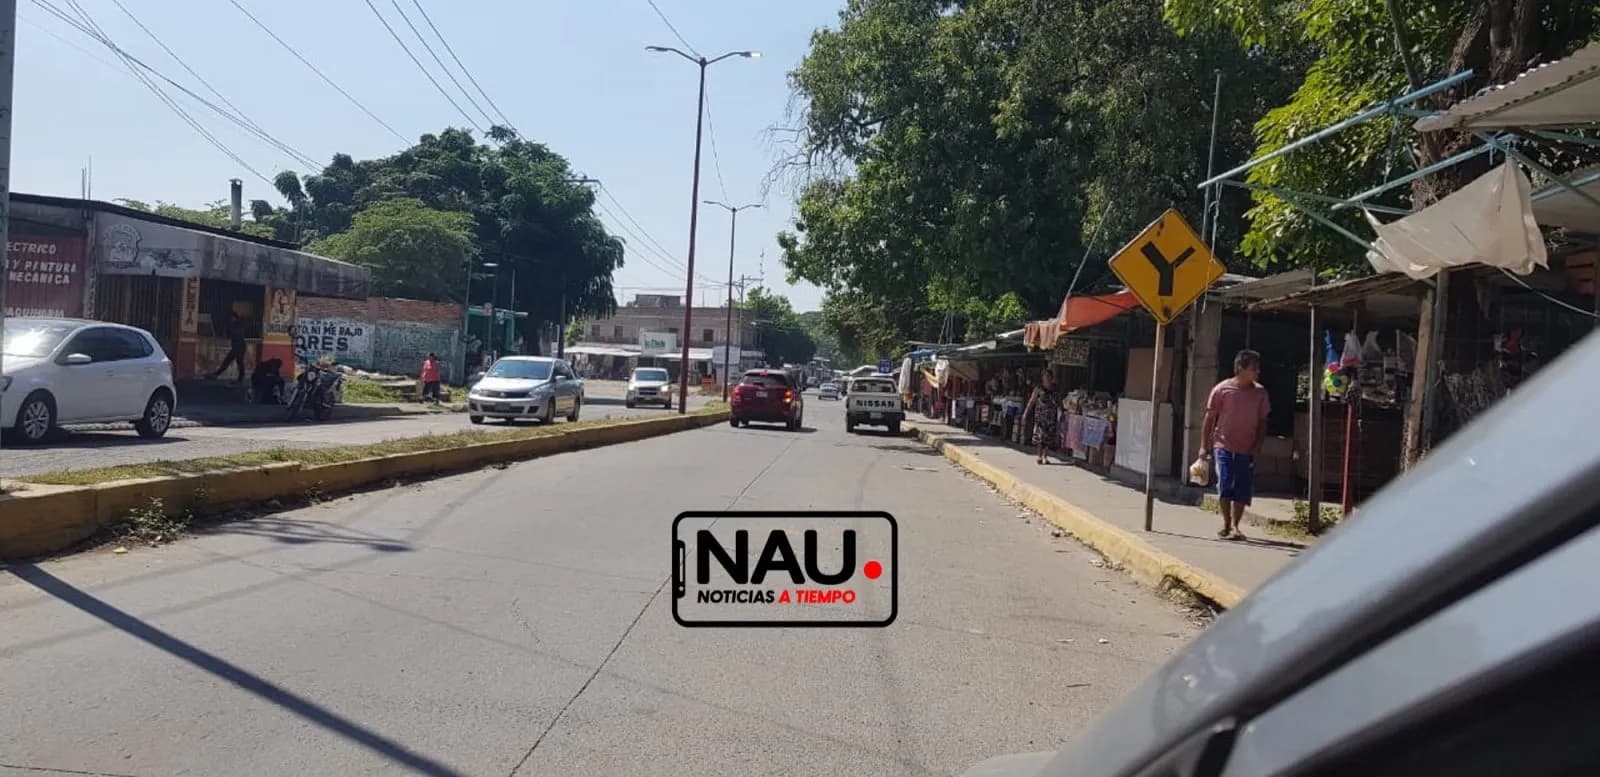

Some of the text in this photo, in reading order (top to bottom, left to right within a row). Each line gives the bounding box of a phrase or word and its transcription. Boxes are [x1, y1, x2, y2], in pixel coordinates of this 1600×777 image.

[25, 261, 77, 273] PINTURA
[9, 272, 70, 284] MECANICA
[311, 325, 321, 336] NI
[323, 326, 337, 337] ME
[856, 399, 895, 408] NISSAN
